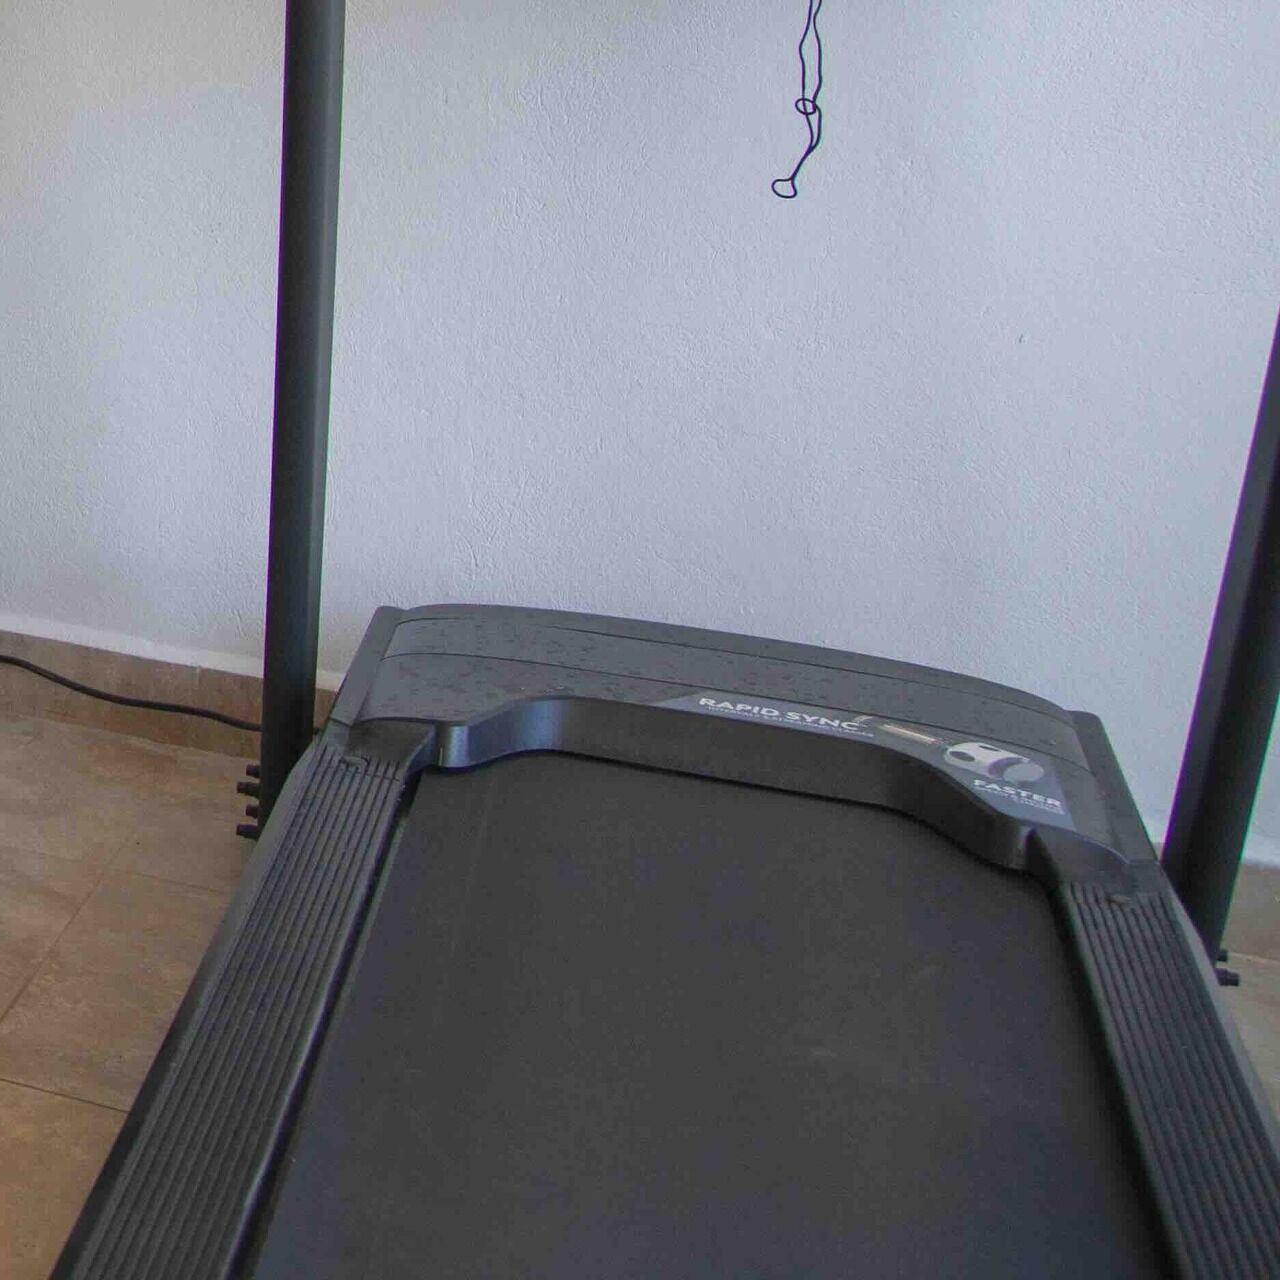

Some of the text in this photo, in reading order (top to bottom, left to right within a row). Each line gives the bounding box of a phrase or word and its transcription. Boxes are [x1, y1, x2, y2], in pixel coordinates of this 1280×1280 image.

[699, 697, 780, 717] RAPID
[786, 711, 862, 731] SYNC
[973, 779, 1063, 808] FASTER
